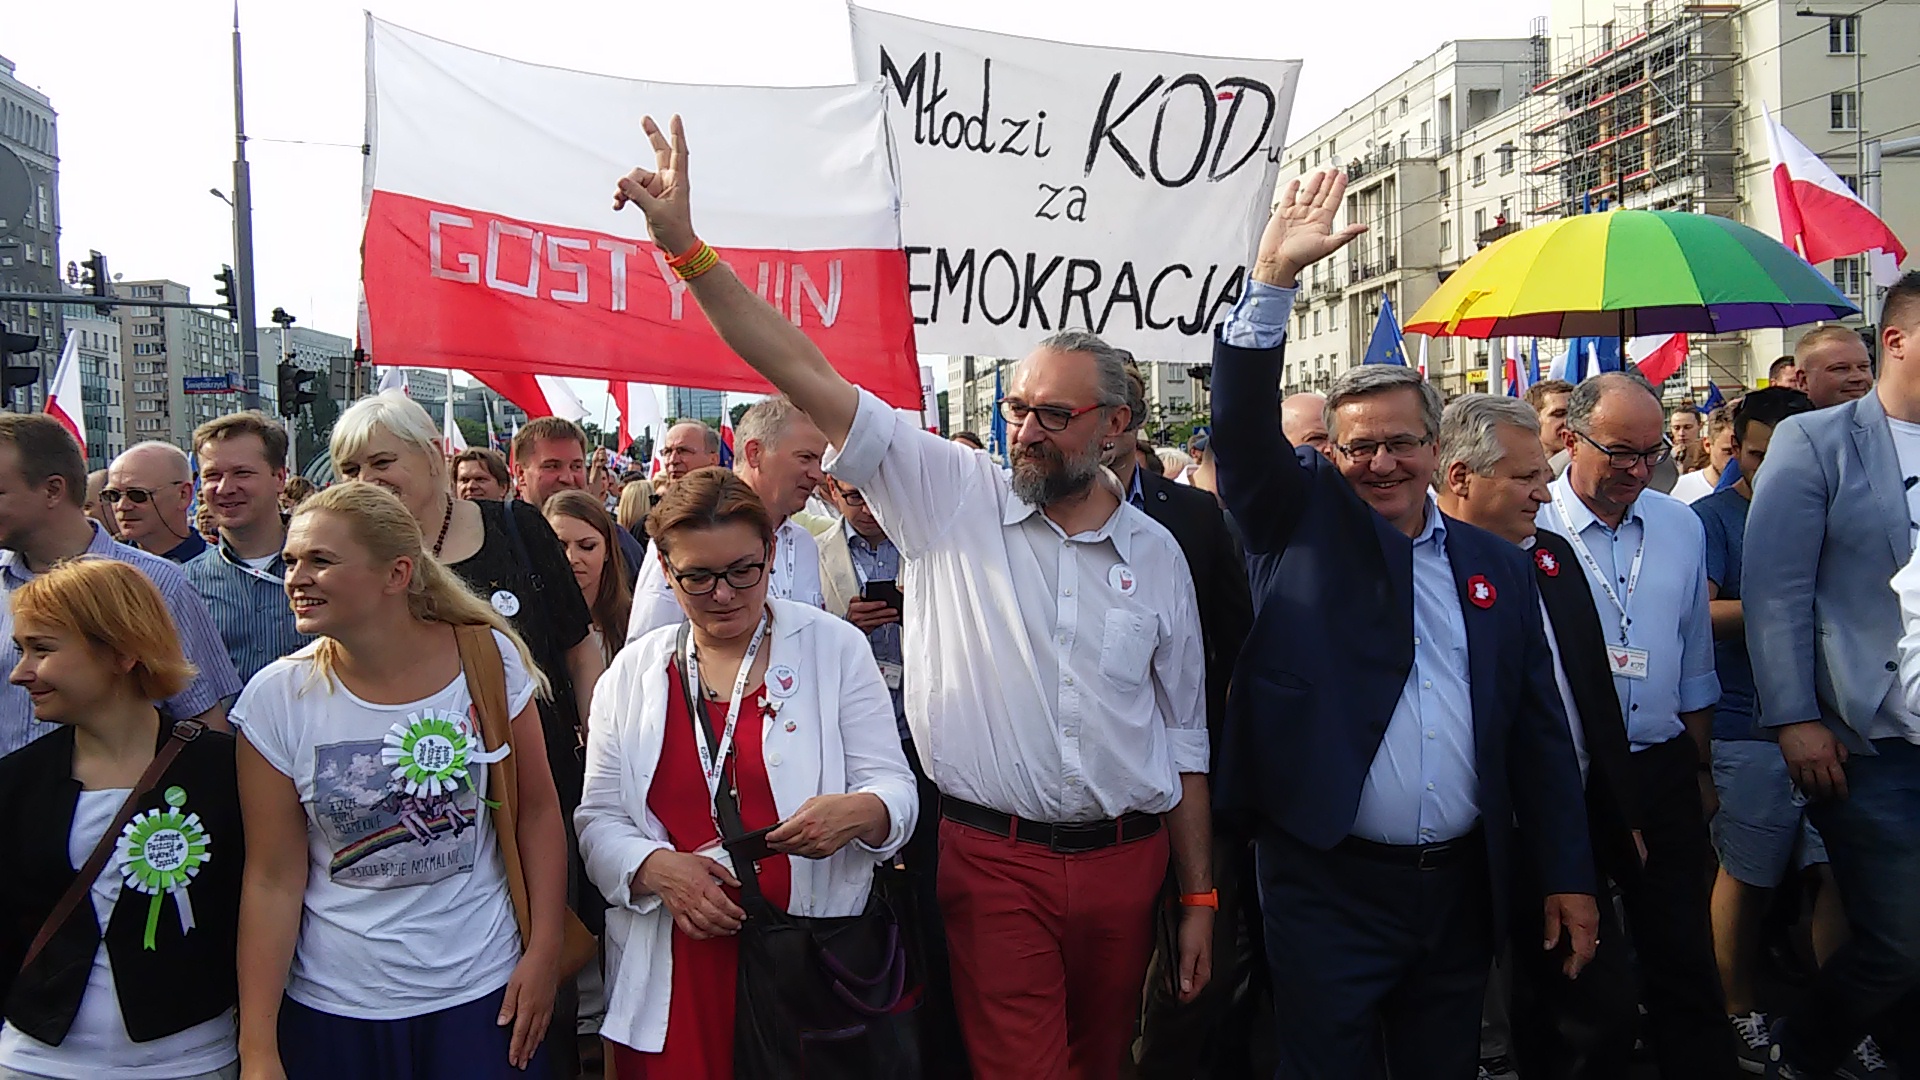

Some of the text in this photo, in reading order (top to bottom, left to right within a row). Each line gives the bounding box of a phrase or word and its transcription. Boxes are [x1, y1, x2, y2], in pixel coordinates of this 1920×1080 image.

[880, 43, 1051, 158] Młodzi
[1035, 182, 1088, 222] za
[428, 209, 843, 328] GOSTYIN
[904, 245, 1246, 336] EMOKRACJA
[185, 379, 228, 390] Świętokrzysk
